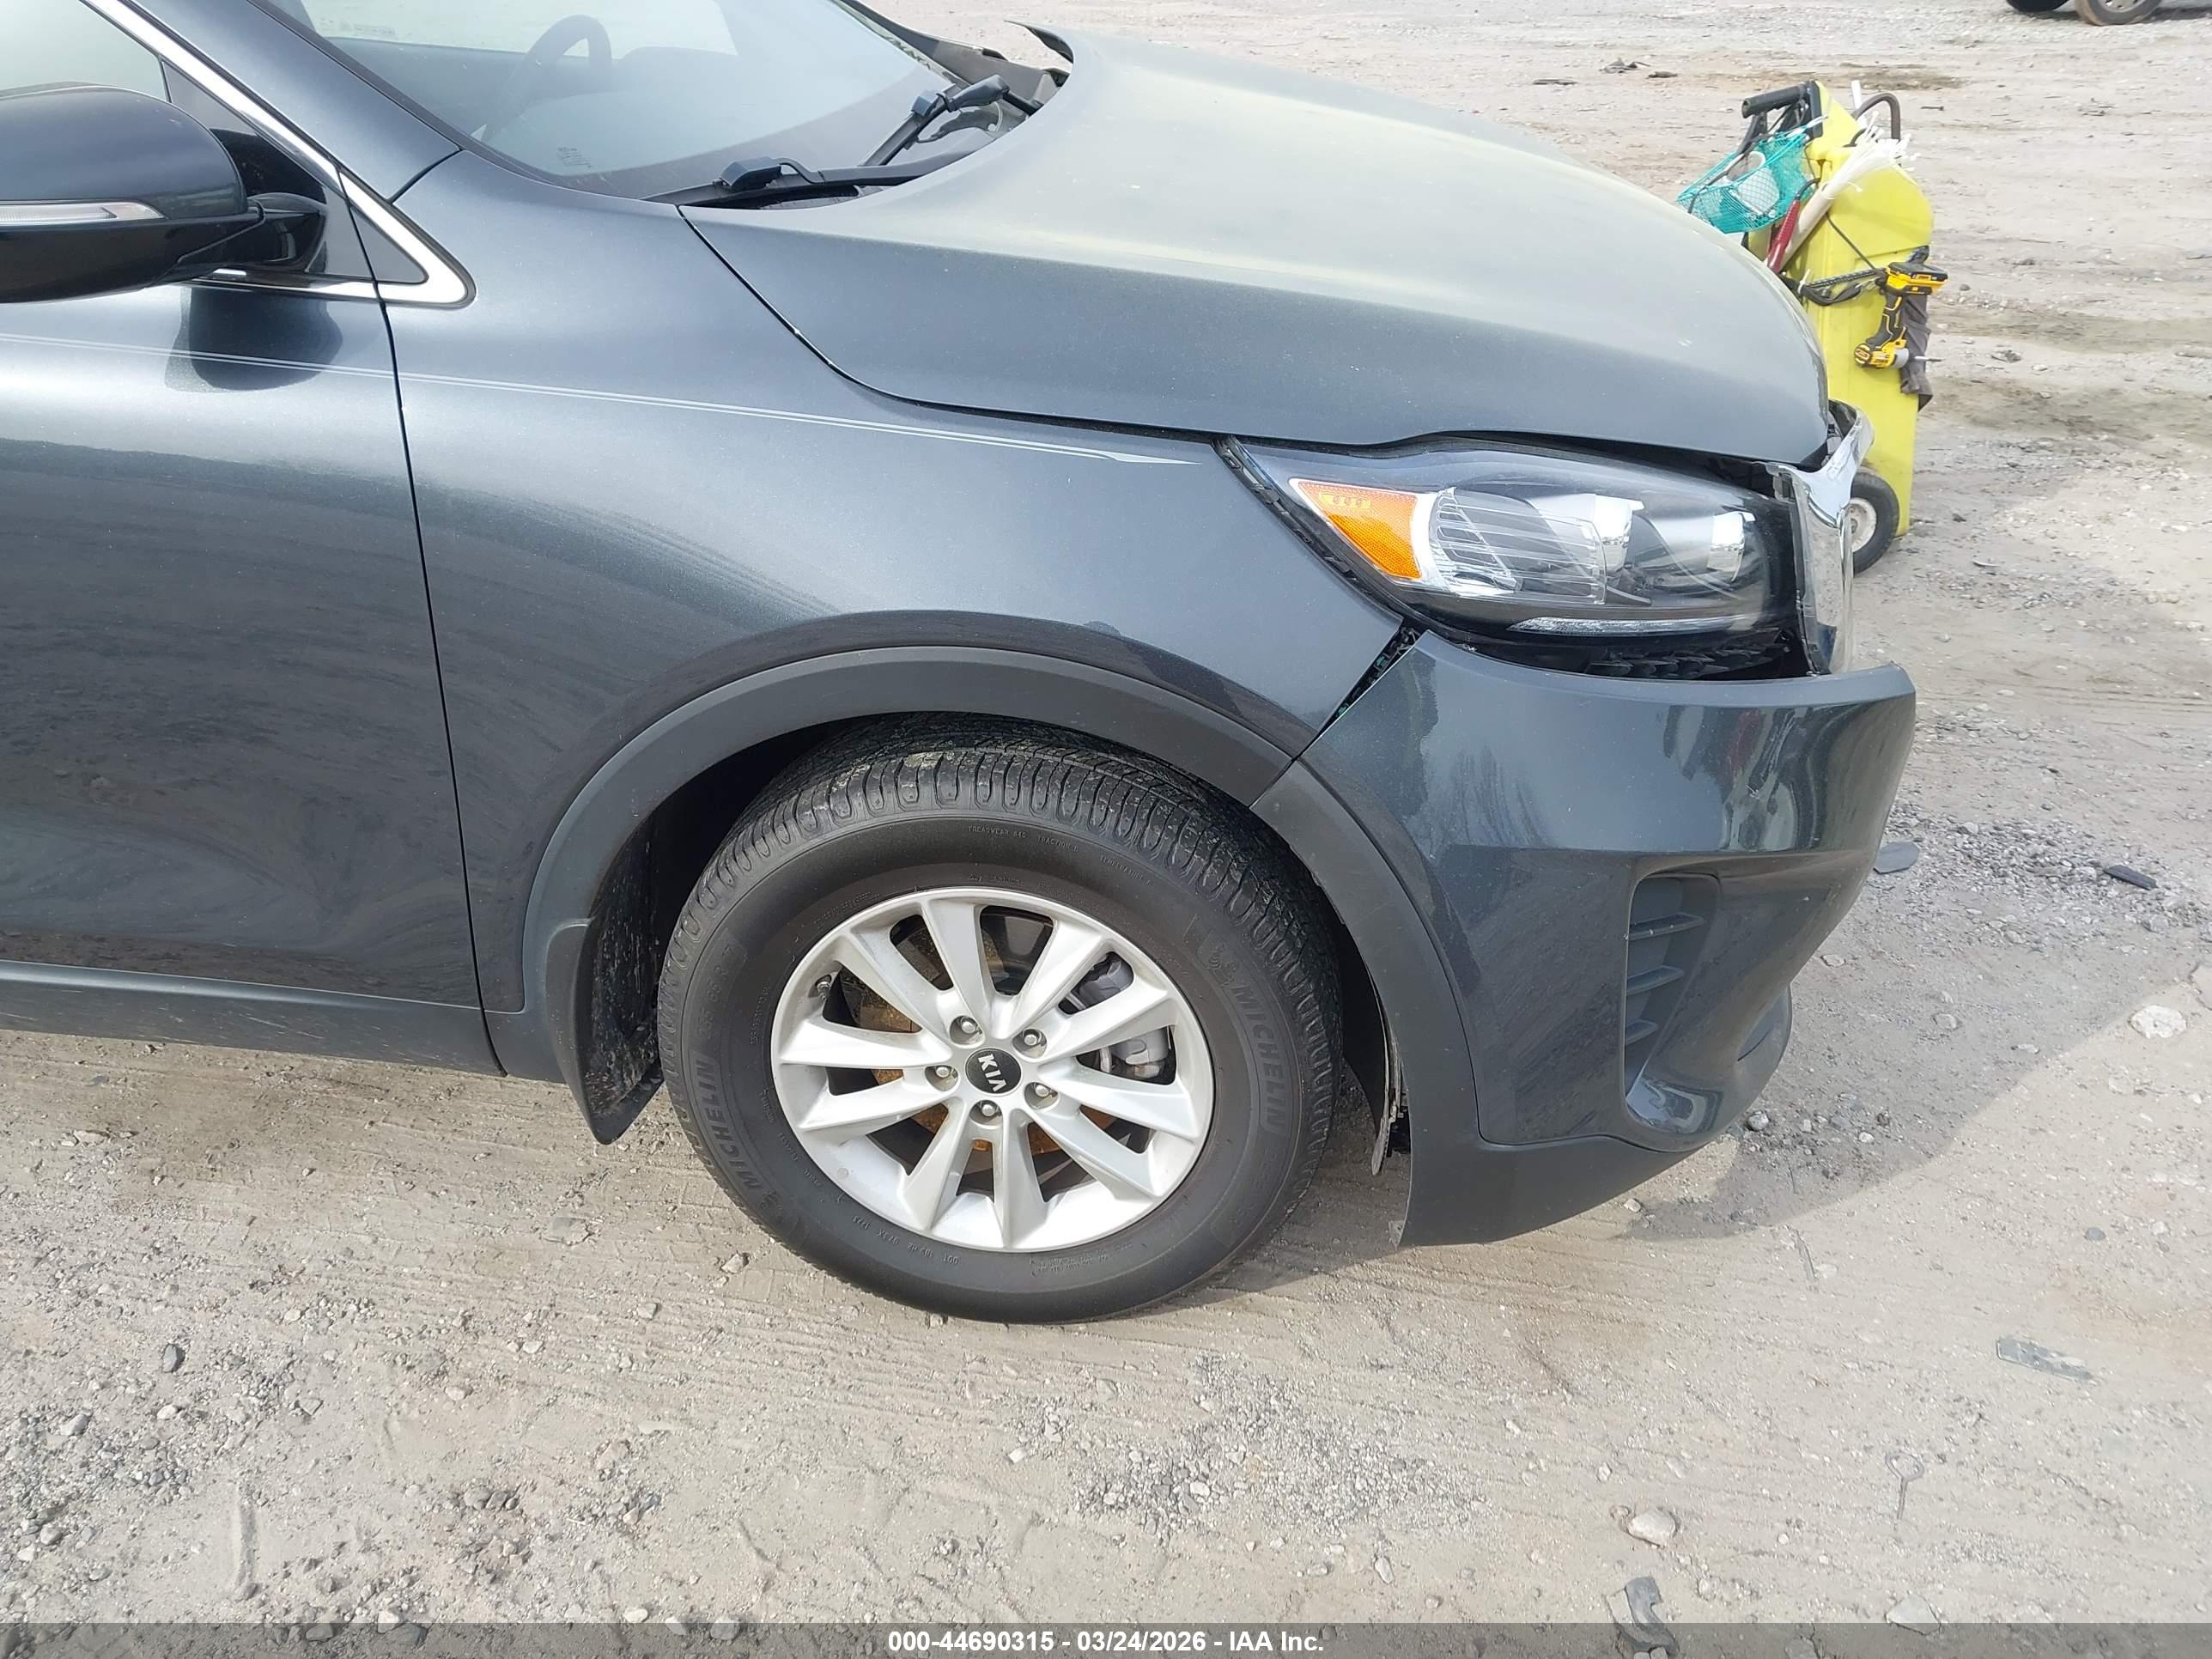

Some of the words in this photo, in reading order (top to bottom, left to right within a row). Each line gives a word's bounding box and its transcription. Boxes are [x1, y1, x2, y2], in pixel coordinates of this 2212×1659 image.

[694, 1057, 765, 1191] MICHELIN
[977, 1053, 1007, 1092] KIA
[1228, 984, 1287, 1133] MICHELIN
